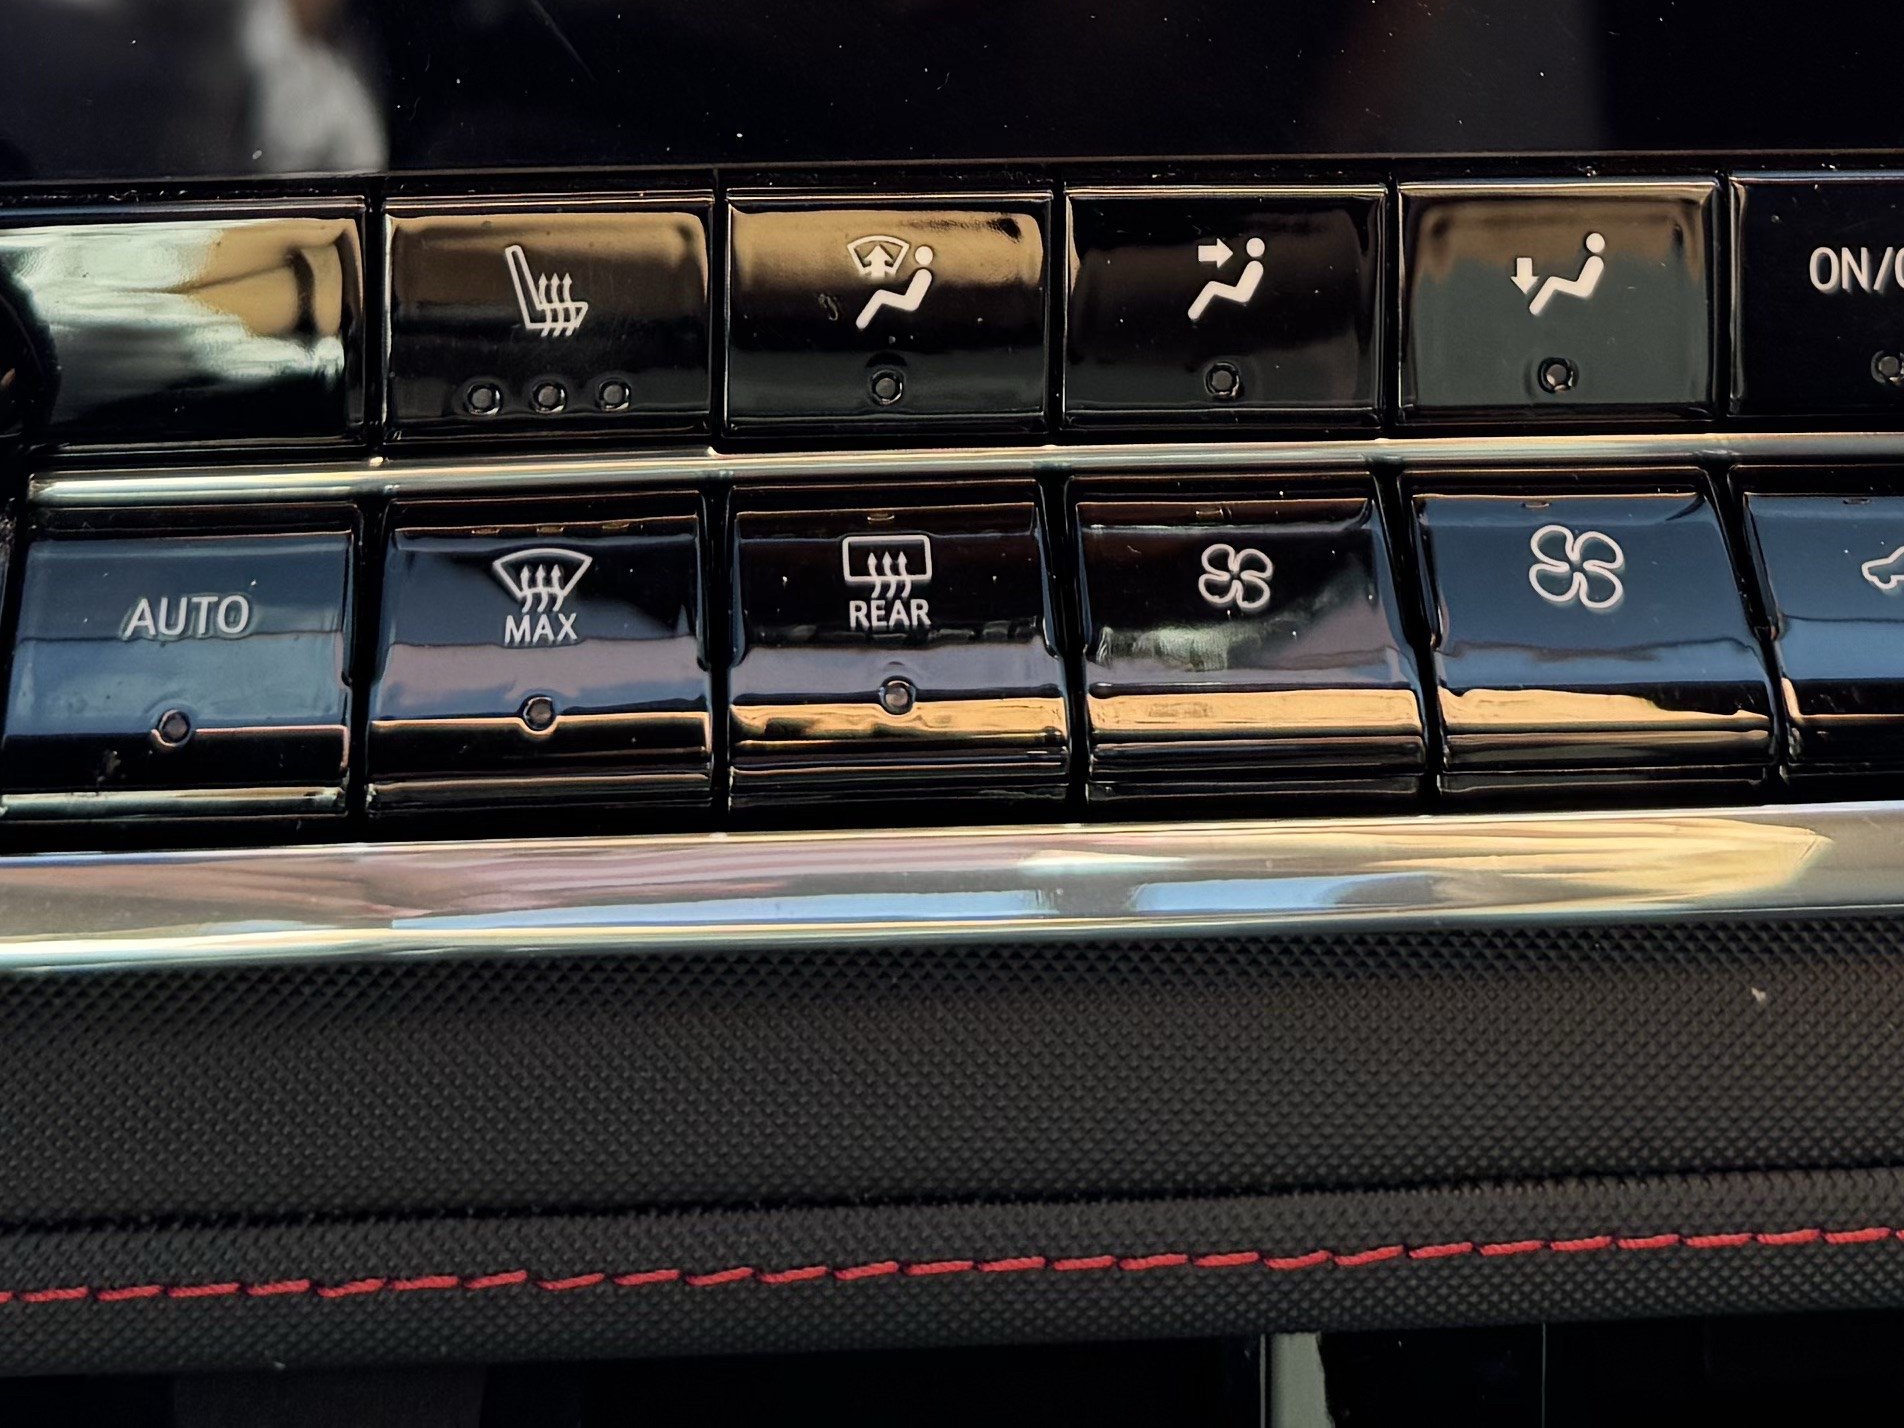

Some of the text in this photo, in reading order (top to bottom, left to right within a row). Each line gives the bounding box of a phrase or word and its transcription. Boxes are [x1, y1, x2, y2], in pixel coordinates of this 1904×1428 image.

[123, 594, 250, 638] AUTO
[504, 614, 578, 643] MAX
[849, 599, 931, 630] REAR
